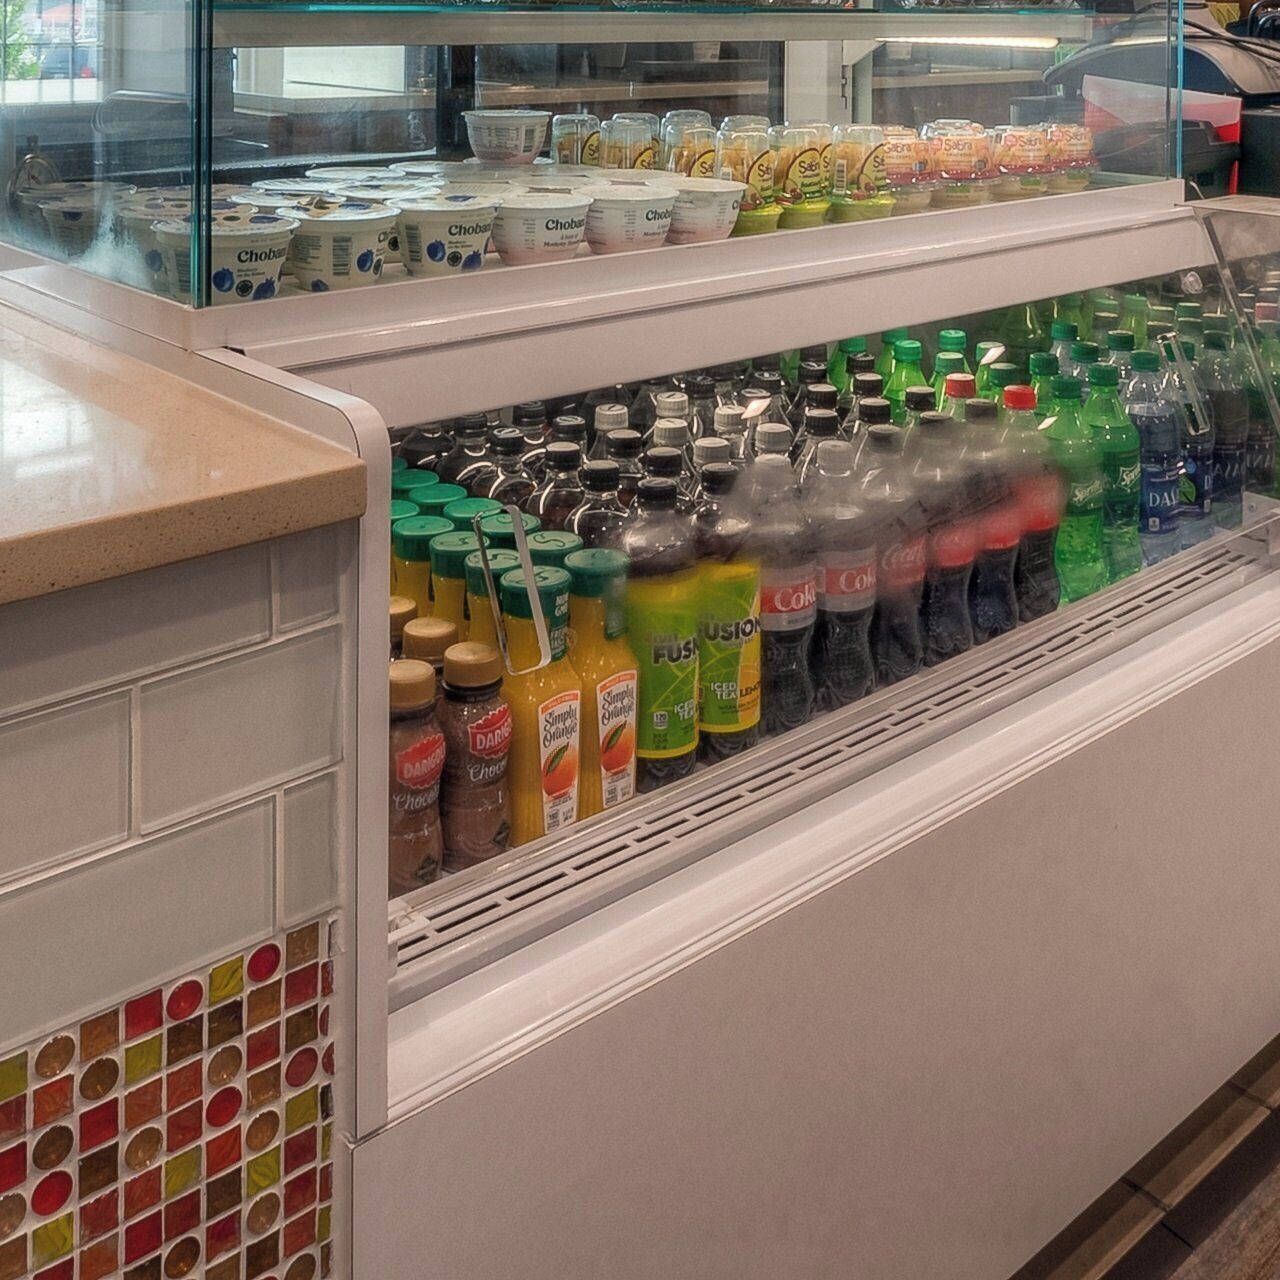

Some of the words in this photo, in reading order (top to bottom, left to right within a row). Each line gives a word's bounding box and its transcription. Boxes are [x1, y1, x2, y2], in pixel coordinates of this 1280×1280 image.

[944, 139, 973, 151] Sabra
[603, 685, 635, 711] Simply
[711, 682, 737, 691] ICED
[715, 690, 737, 700] TEA
[544, 704, 578, 733] Simply
[602, 700, 635, 727] Orange
[543, 721, 578, 750] Orange
